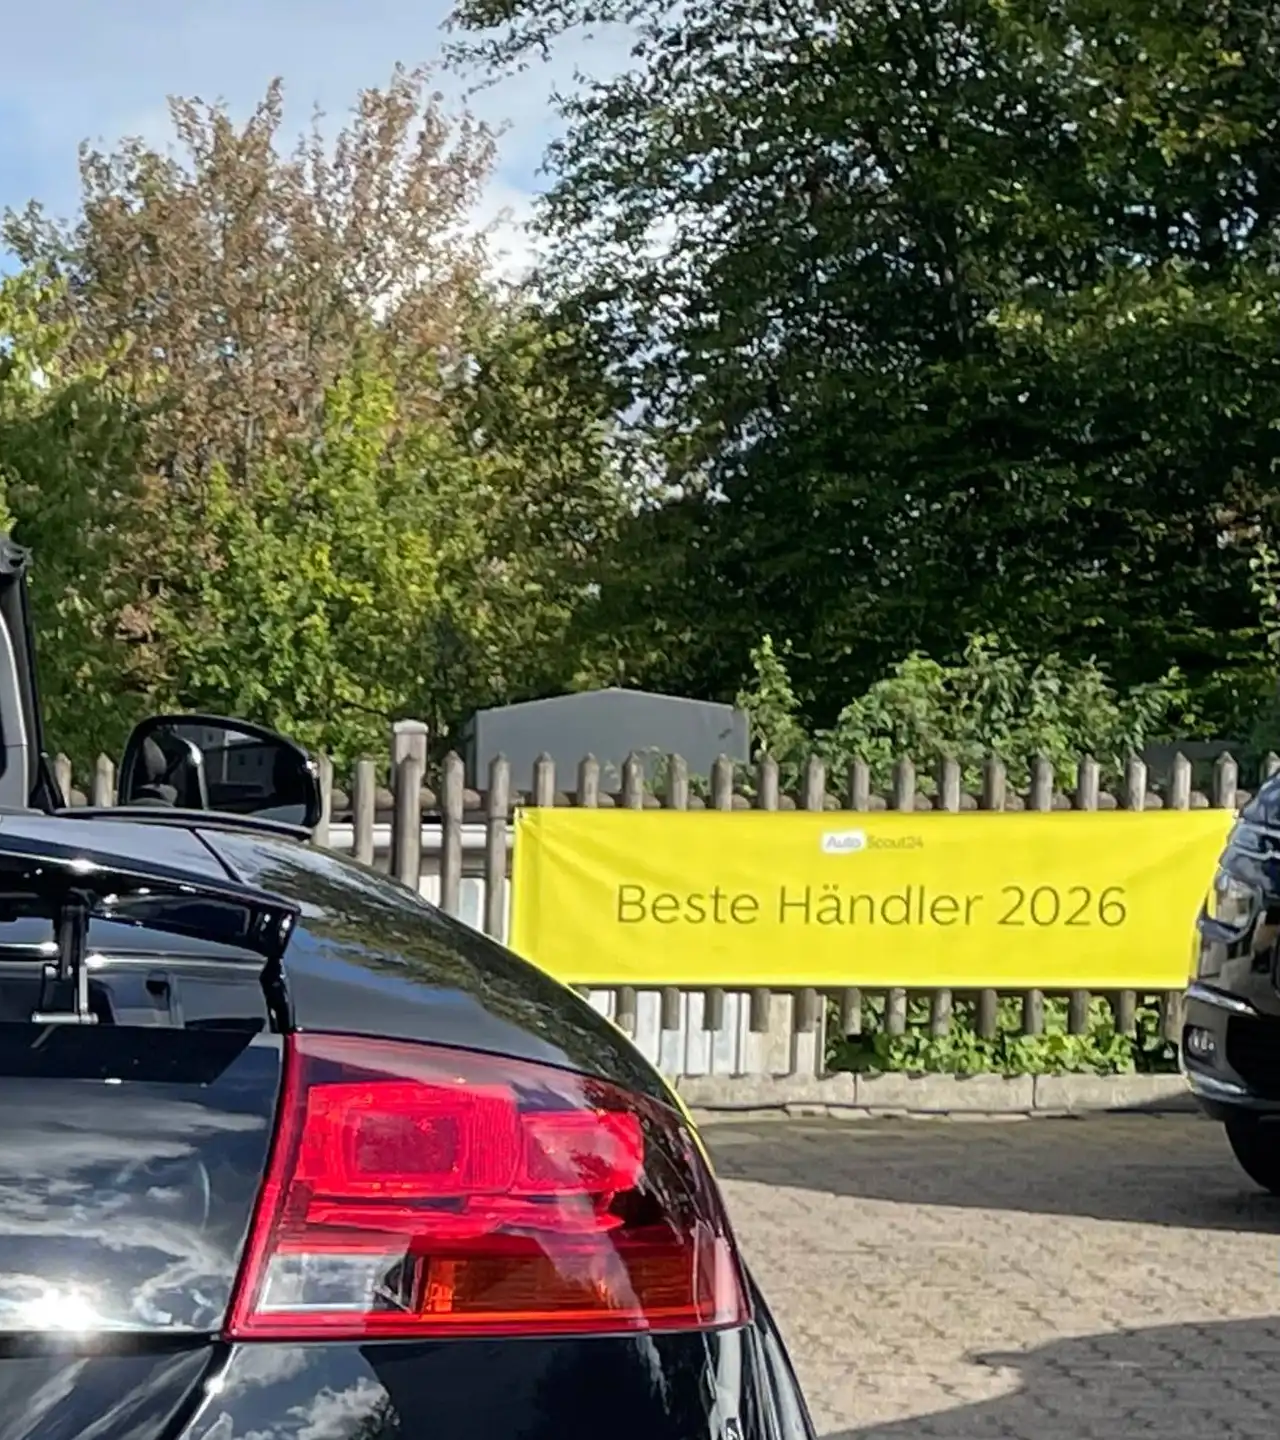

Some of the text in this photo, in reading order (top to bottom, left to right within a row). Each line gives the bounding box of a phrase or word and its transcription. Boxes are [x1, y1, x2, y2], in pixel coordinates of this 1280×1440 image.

[617, 884, 1127, 927] Beste Händler 2026
